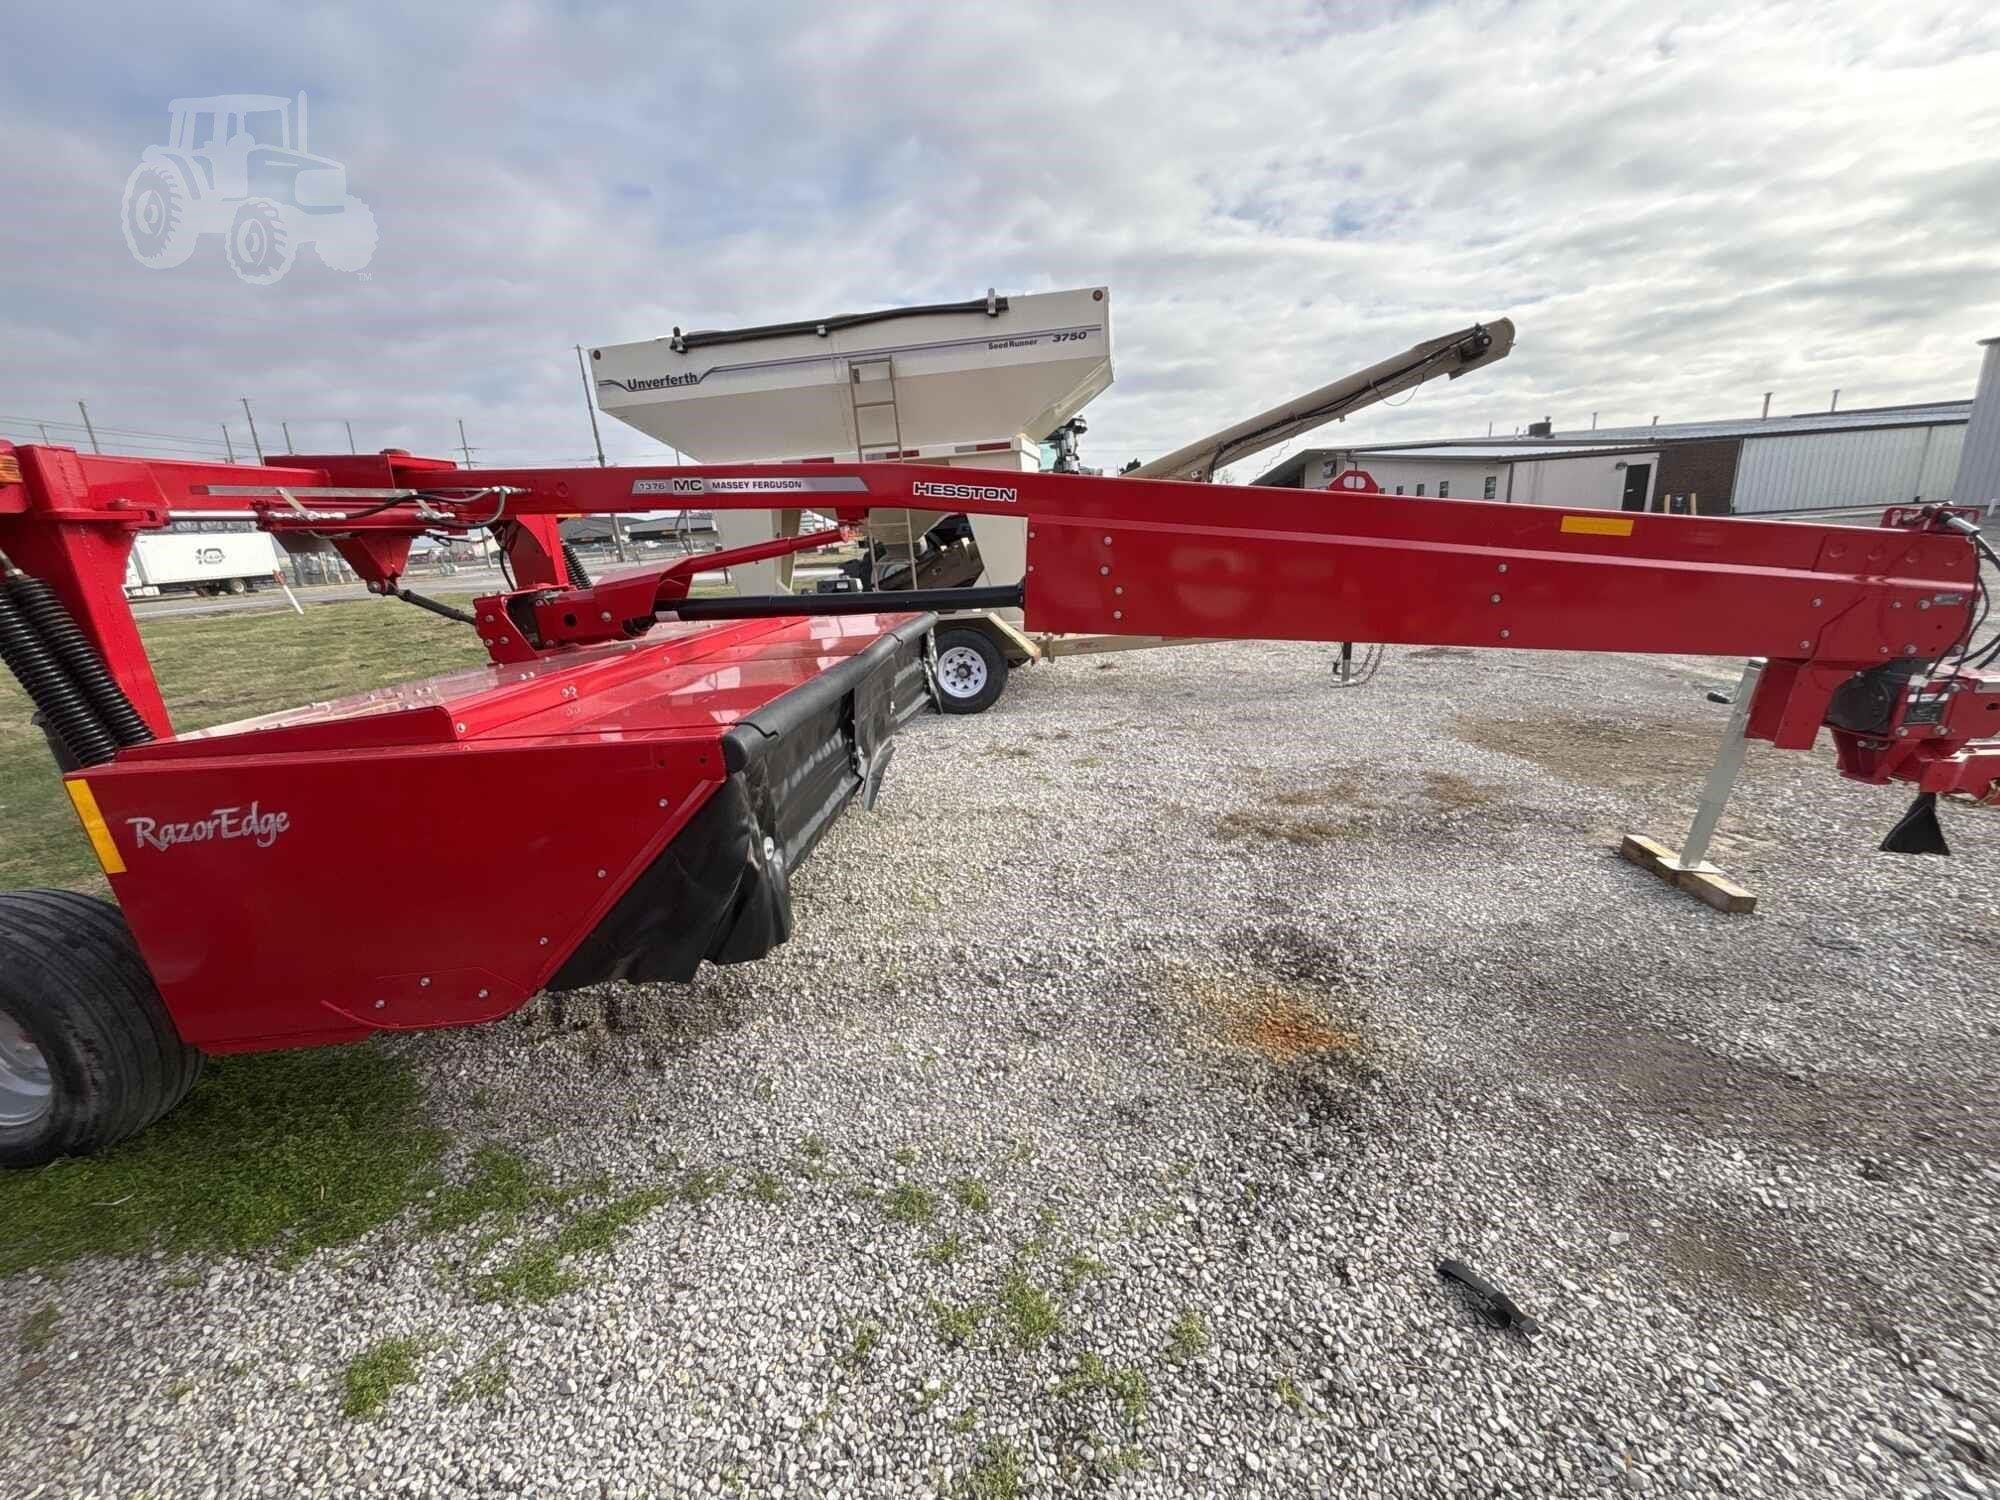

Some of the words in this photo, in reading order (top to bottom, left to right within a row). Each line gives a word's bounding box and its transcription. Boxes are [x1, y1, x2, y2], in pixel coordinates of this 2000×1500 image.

[1052, 331, 1087, 343] 3750
[627, 371, 698, 390] Unverferth
[673, 479, 702, 491] MC
[712, 480, 749, 489] MASSEY
[752, 480, 802, 489] FERGUSON
[912, 481, 1017, 503] HESSTON
[125, 800, 290, 852] RazorEdge
